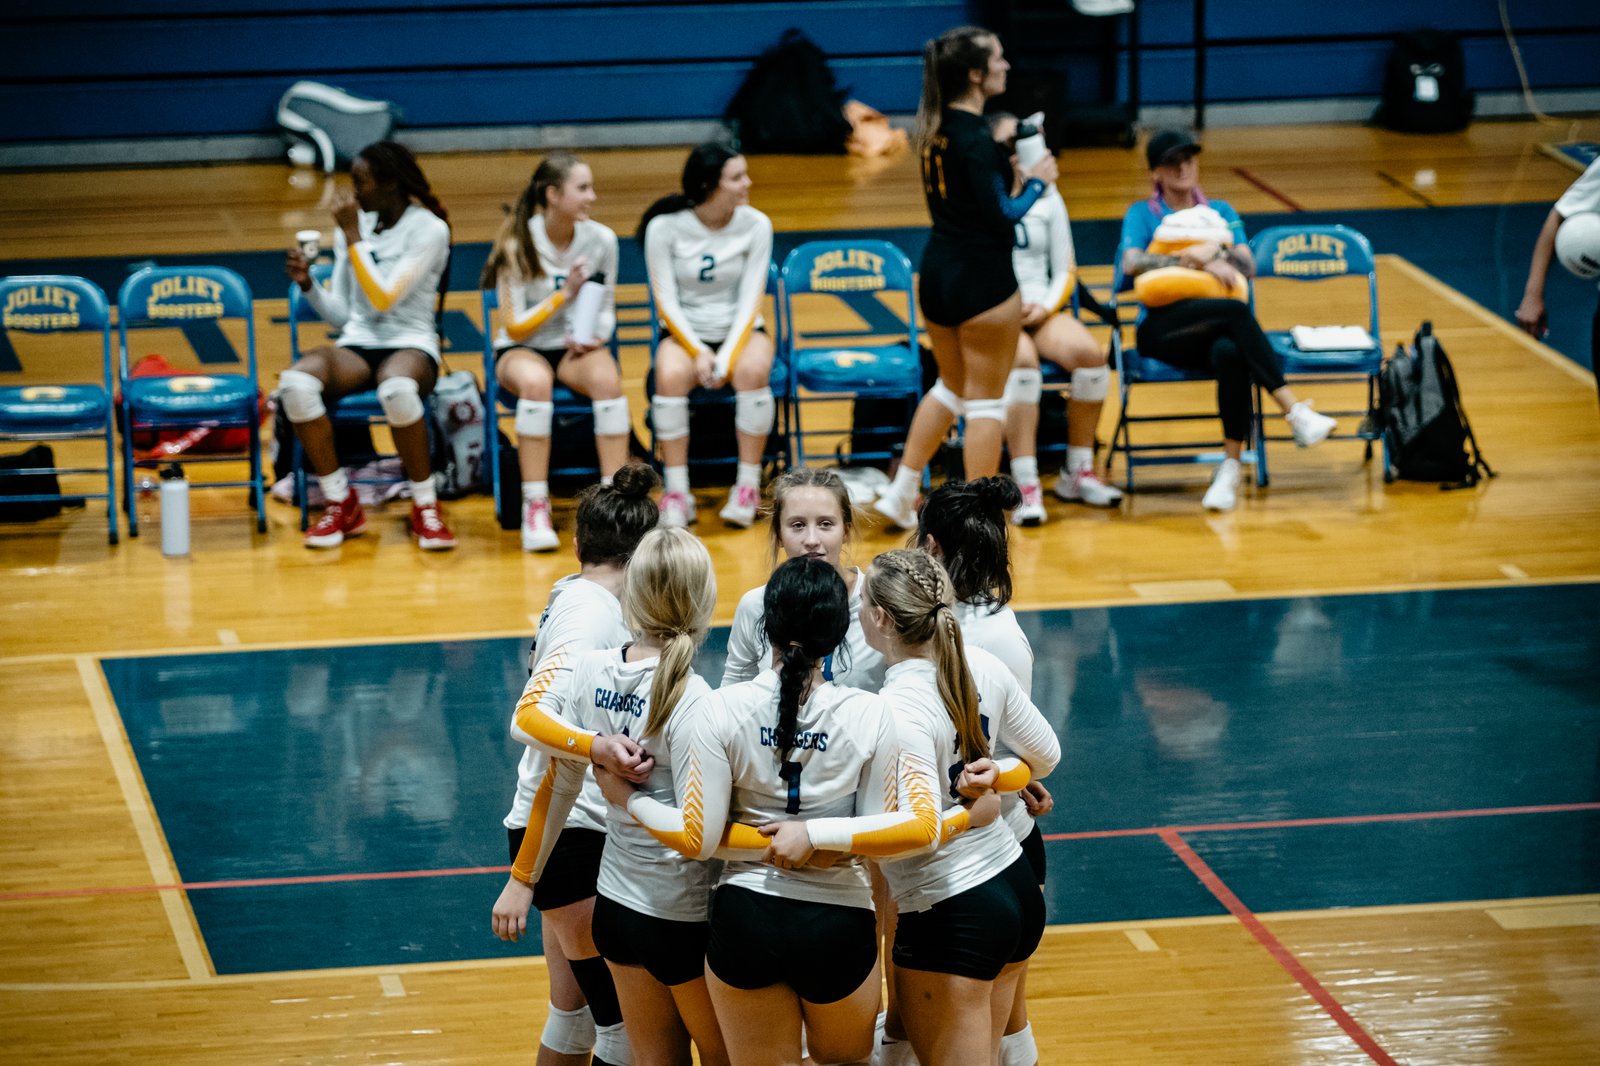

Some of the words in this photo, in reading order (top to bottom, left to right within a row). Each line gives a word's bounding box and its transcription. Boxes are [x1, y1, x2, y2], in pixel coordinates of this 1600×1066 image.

[1274, 233, 1346, 260] JOLIET
[699, 255, 715, 282] 2
[811, 249, 885, 276] JOLIET
[3, 286, 80, 313] JOLIET
[147, 276, 224, 304] JOLIET
[3, 312, 80, 329] BOOSTERS
[760, 726, 828, 752] CHGERS
[778, 761, 803, 815] 1
